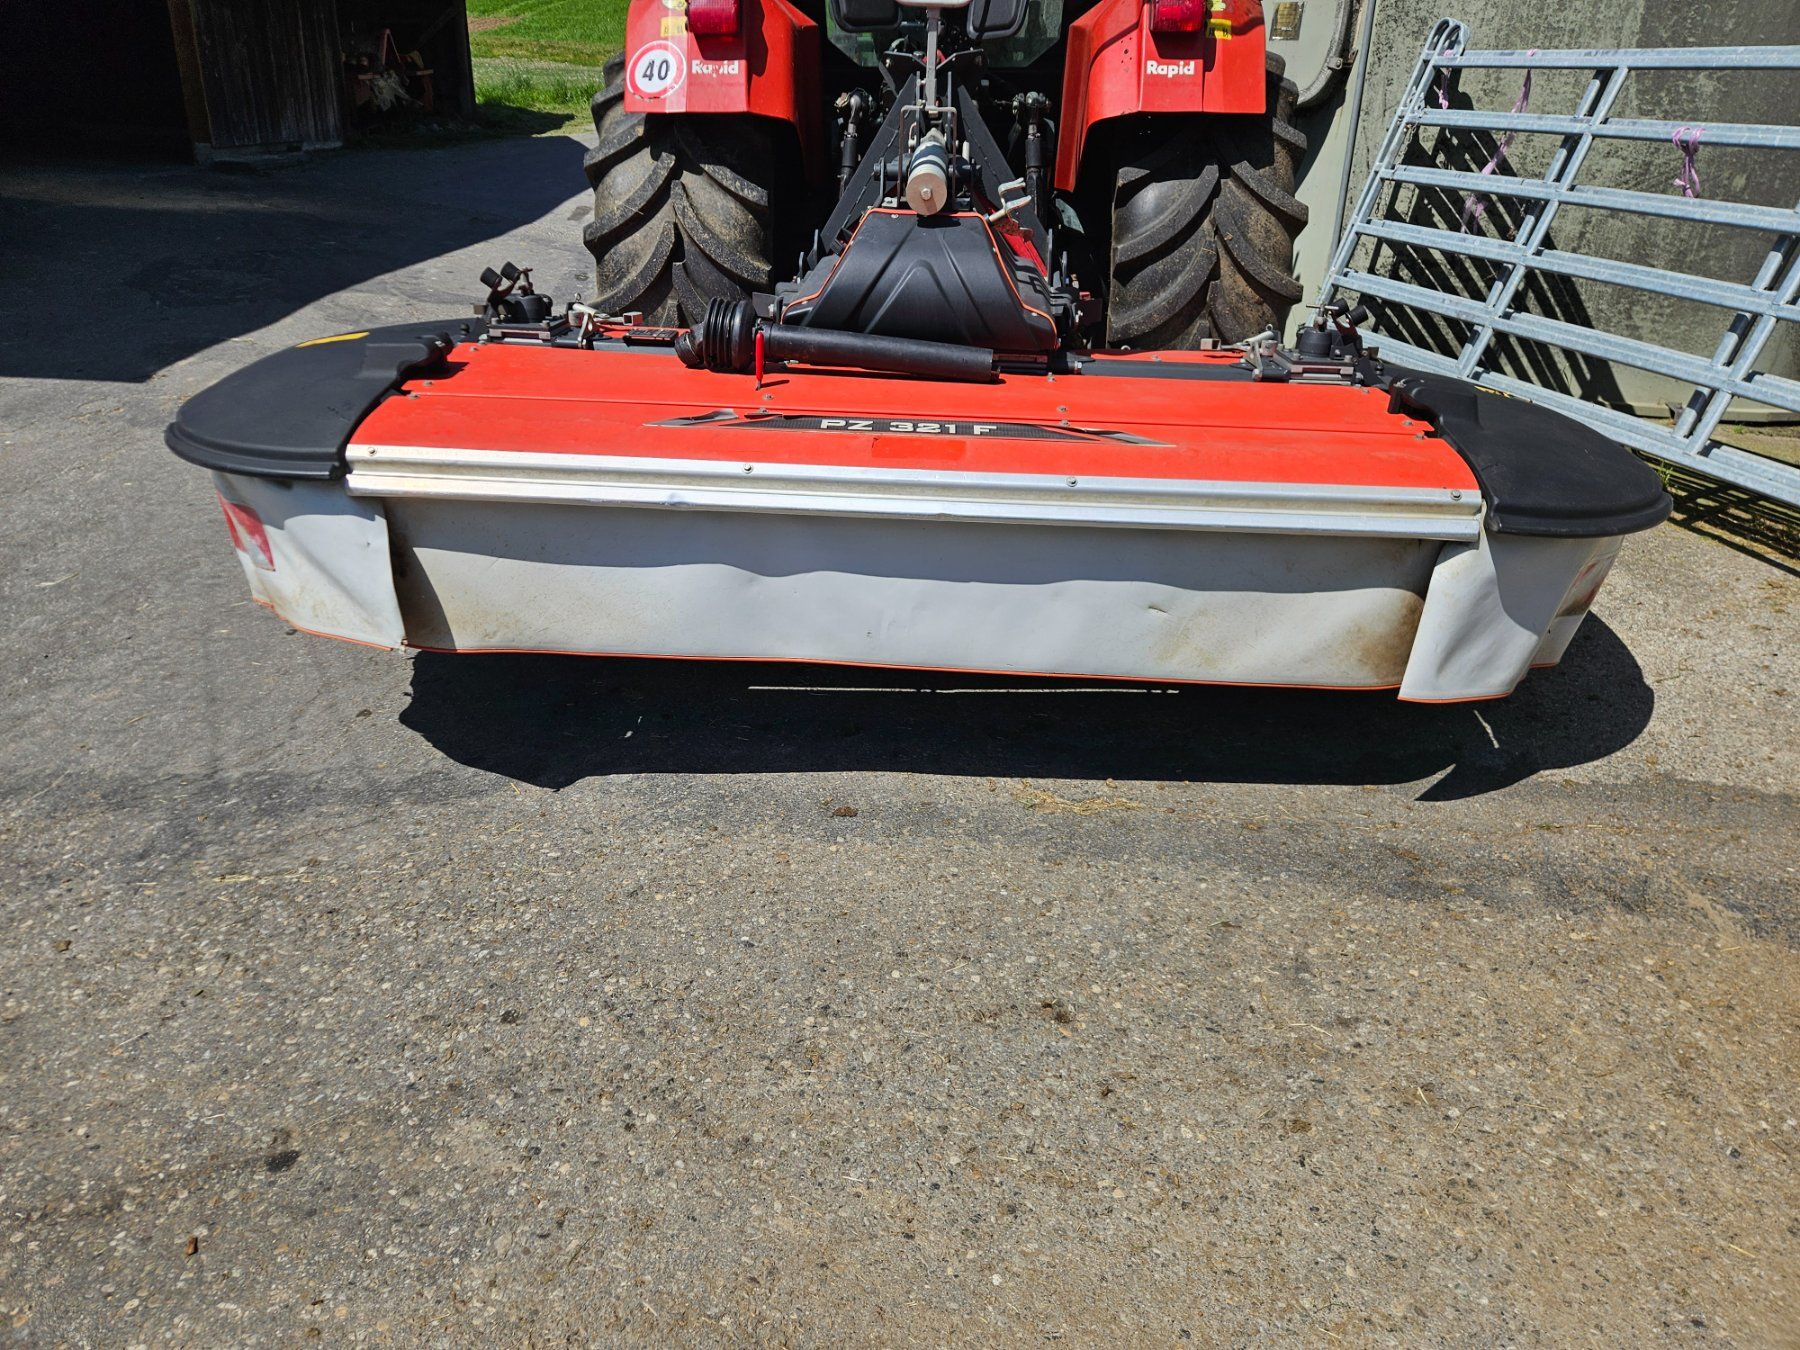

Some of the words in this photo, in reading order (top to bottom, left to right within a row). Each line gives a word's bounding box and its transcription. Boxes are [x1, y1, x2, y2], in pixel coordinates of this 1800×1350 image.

[642, 60, 671, 81] 40
[1146, 60, 1195, 78] Rapid
[820, 419, 874, 431] PZ
[889, 421, 956, 434] 321
[973, 424, 998, 435] F
